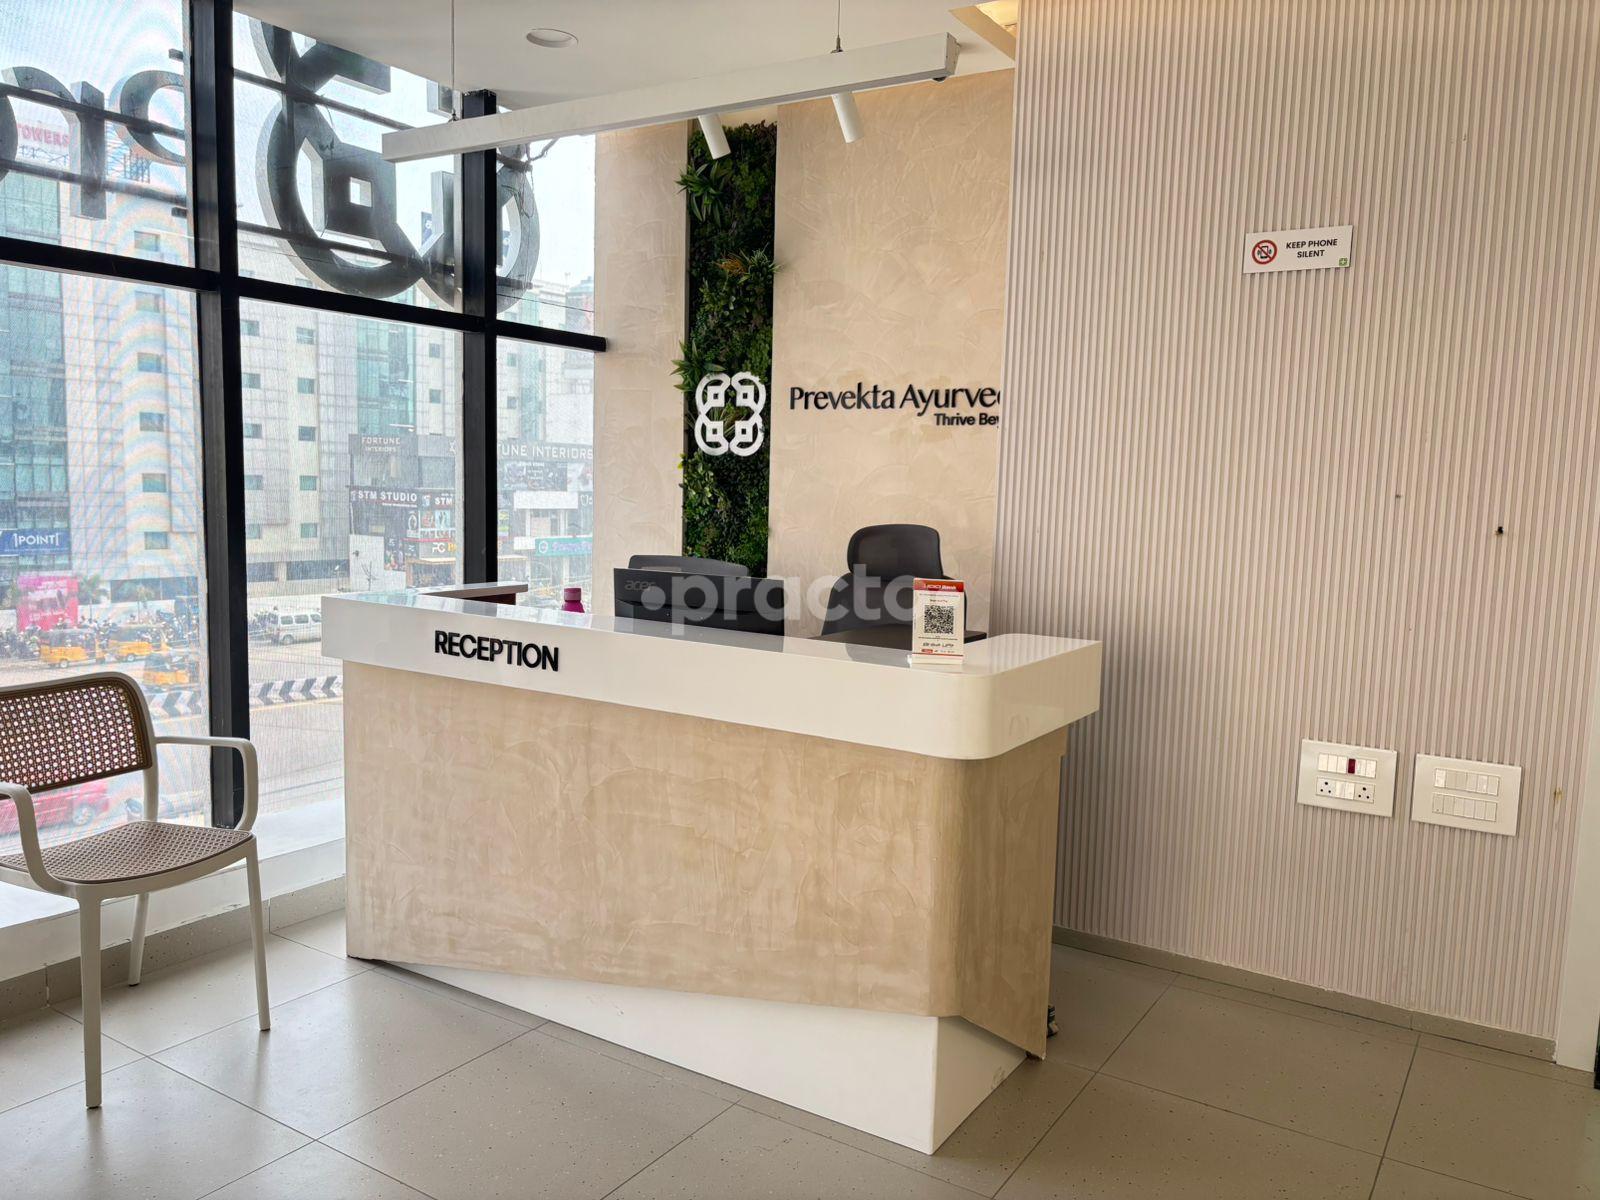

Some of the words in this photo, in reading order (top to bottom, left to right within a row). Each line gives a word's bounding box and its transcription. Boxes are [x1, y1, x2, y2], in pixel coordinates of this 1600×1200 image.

[1286, 241, 1306, 249] KEEP
[1308, 238, 1338, 248] PHONE
[1297, 249, 1326, 258] SILENT
[790, 382, 895, 410] Prevekta
[900, 384, 1000, 416] Ayurve
[934, 413, 976, 426] Thrive
[361, 436, 401, 445] FORTUNE
[358, 491, 378, 501] STM
[380, 491, 417, 502] STUDIO
[435, 630, 559, 672] RECEPTION
